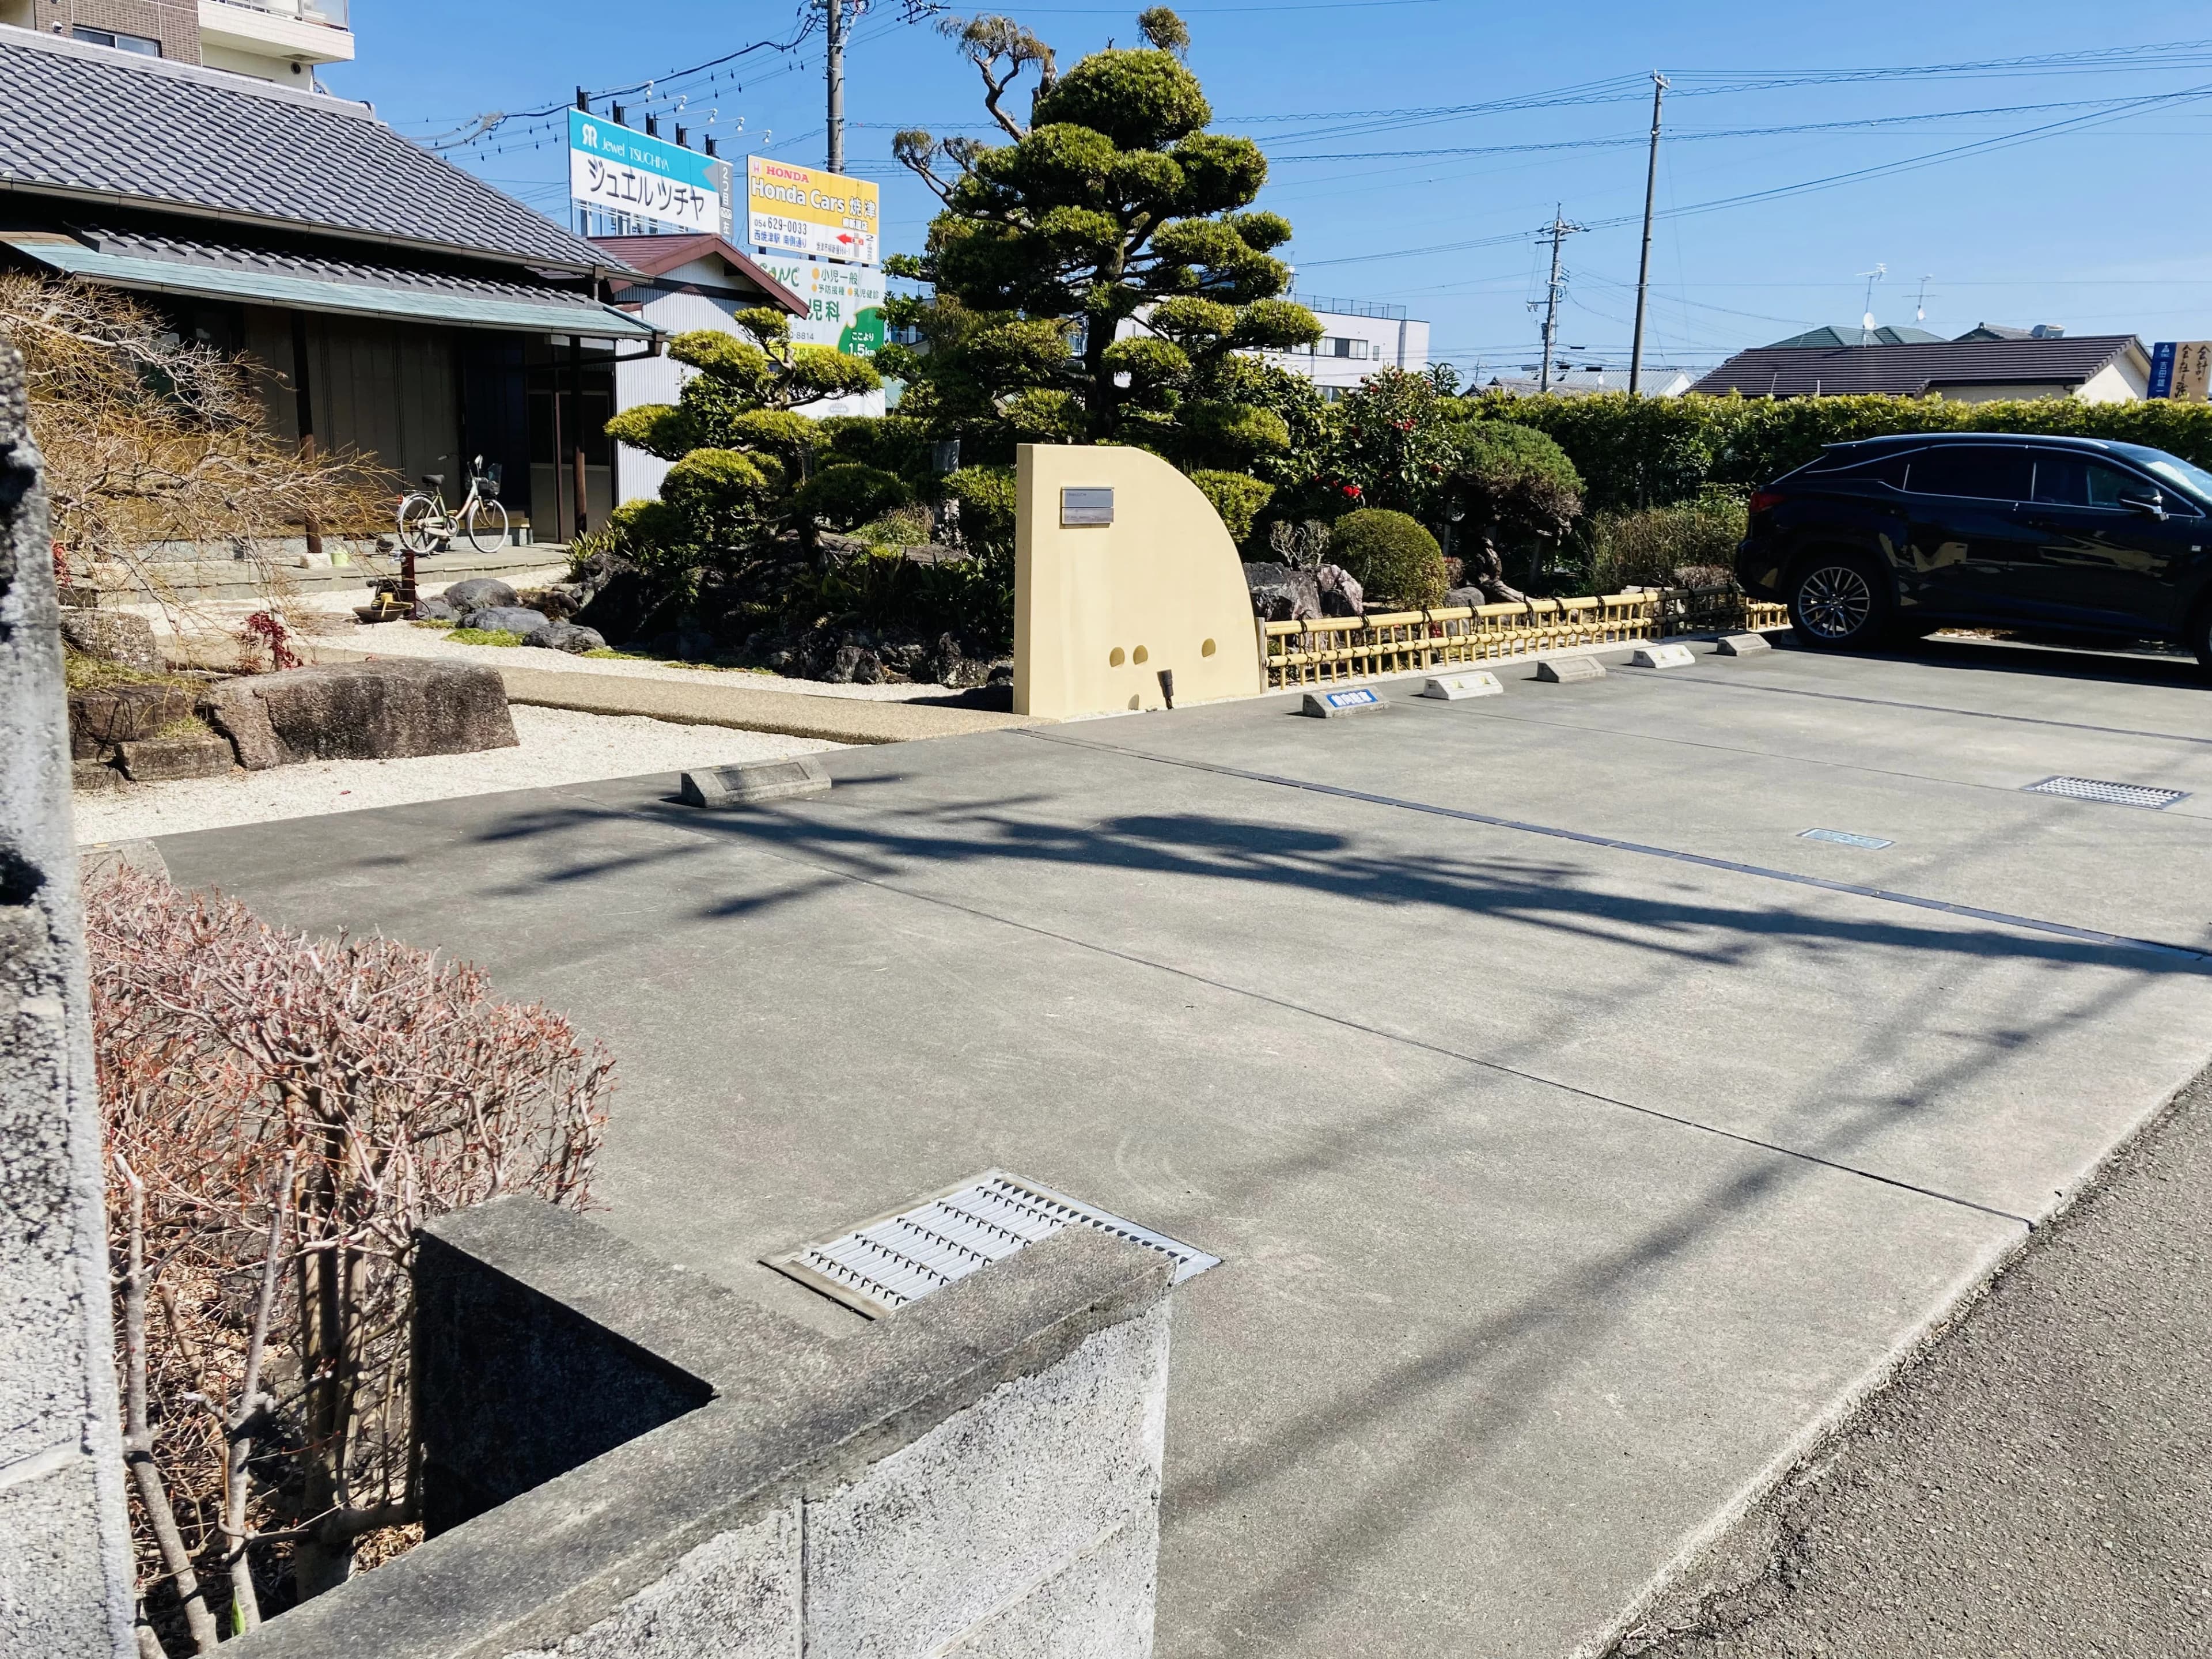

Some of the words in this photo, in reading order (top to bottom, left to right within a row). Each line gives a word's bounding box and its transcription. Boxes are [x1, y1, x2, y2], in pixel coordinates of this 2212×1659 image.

[601, 137, 625, 157] Jewel
[629, 146, 670, 172] TSUCHIYA
[766, 165, 809, 183] HONDA
[588, 158, 704, 221] ジュエルツチヤ
[751, 176, 806, 206] Honda
[810, 189, 845, 213] Cars
[849, 196, 876, 219] 焼津
[755, 219, 766, 228] 054
[768, 217, 807, 235] 629-0033
[754, 229, 781, 244] 西焼津駅
[783, 235, 806, 248] 南側通り
[821, 268, 858, 285] 小児一般
[818, 283, 844, 296] 予防接種
[854, 288, 879, 299] 乳児健診
[794, 298, 840, 323] 児科
[852, 331, 874, 342] ここより
[849, 343, 876, 357] 1.5km
